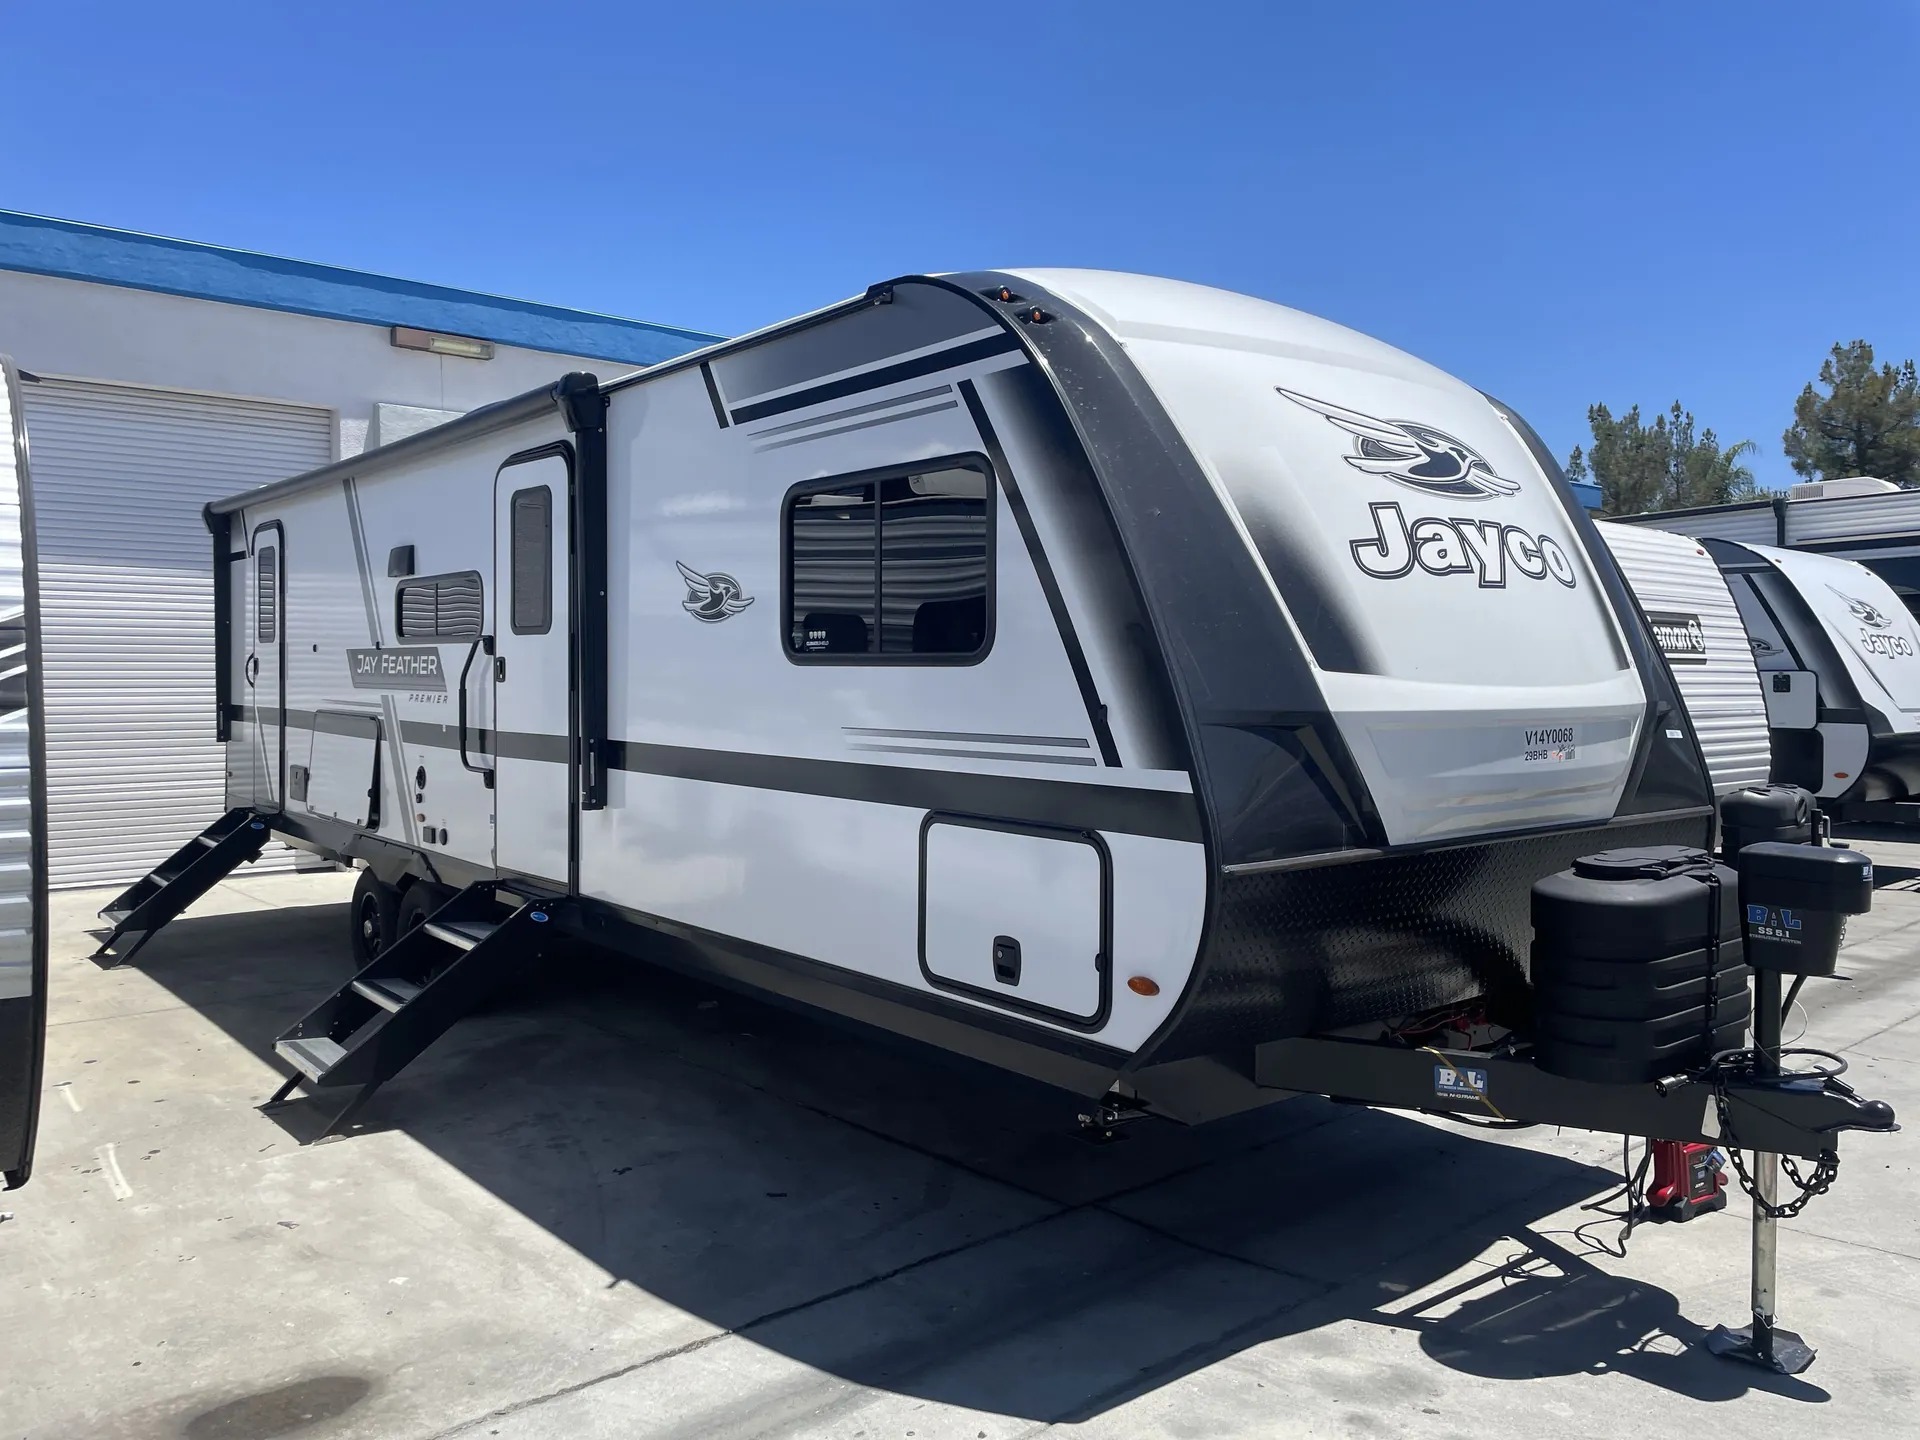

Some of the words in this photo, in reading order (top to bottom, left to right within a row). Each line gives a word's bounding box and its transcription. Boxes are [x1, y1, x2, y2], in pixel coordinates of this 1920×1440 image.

[1349, 501, 1577, 589] Jayco
[1859, 627, 1913, 659] Jayco
[357, 654, 378, 674] JAY
[381, 654, 438, 675] FEATHER
[408, 693, 449, 704] PREMIER
[1525, 727, 1574, 746] V14Y0068
[1524, 749, 1548, 761] 29BHB
[1758, 926, 1773, 935] SS
